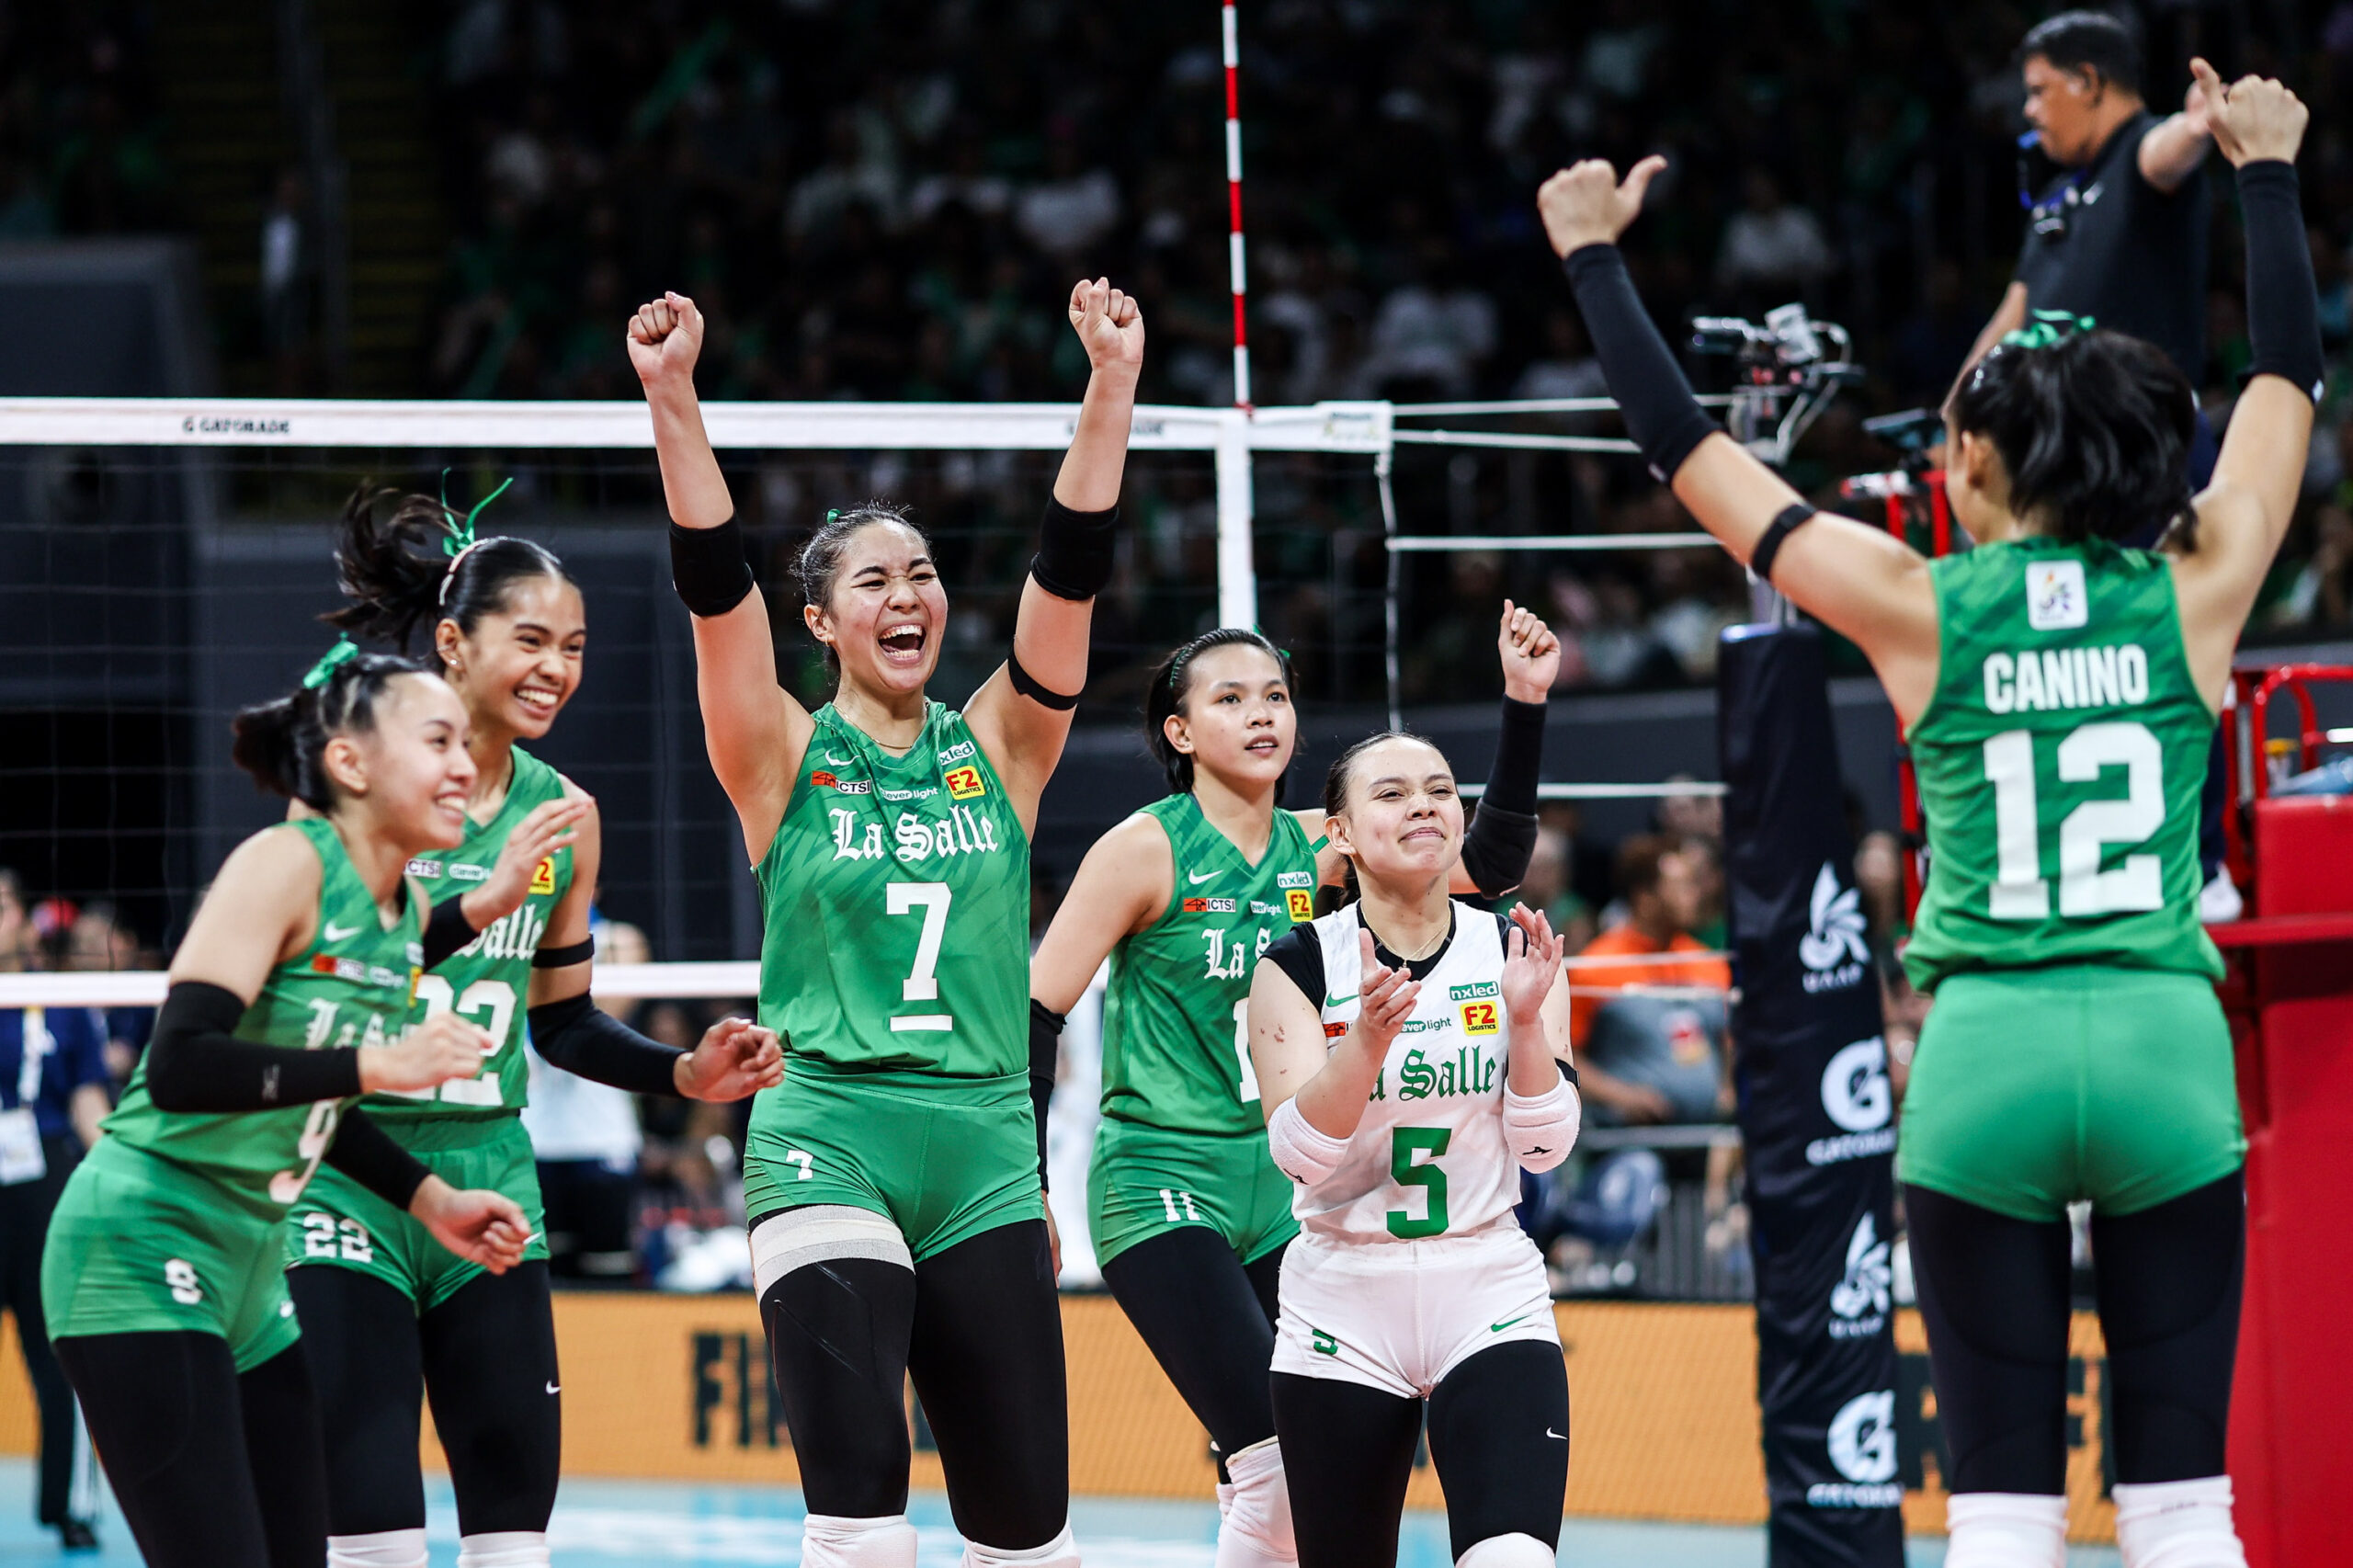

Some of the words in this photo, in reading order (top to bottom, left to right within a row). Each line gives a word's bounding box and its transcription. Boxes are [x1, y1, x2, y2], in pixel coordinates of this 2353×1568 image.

[1983, 643, 2150, 714] CANINO
[835, 779, 870, 793] ICTSI
[946, 770, 979, 790] F2
[954, 787, 981, 796] LOGISTICS
[913, 787, 938, 800] light
[828, 808, 885, 861] La
[894, 804, 998, 862] Salle
[1983, 722, 2165, 919] 12
[1279, 873, 1312, 885] nxled
[1208, 899, 1235, 911] ICTSI
[1290, 894, 1309, 912] F2
[887, 882, 952, 1001] 7
[1201, 928, 1245, 981] La
[1451, 983, 1497, 999] nxled
[1427, 1017, 1451, 1030] light
[1464, 1005, 1495, 1026] F2
[1399, 1045, 1496, 1101] Salle
[786, 1150, 813, 1180] 7
[1386, 1127, 1451, 1239] 5
[1159, 1188, 1200, 1221] 11
[303, 1212, 373, 1263] 22
